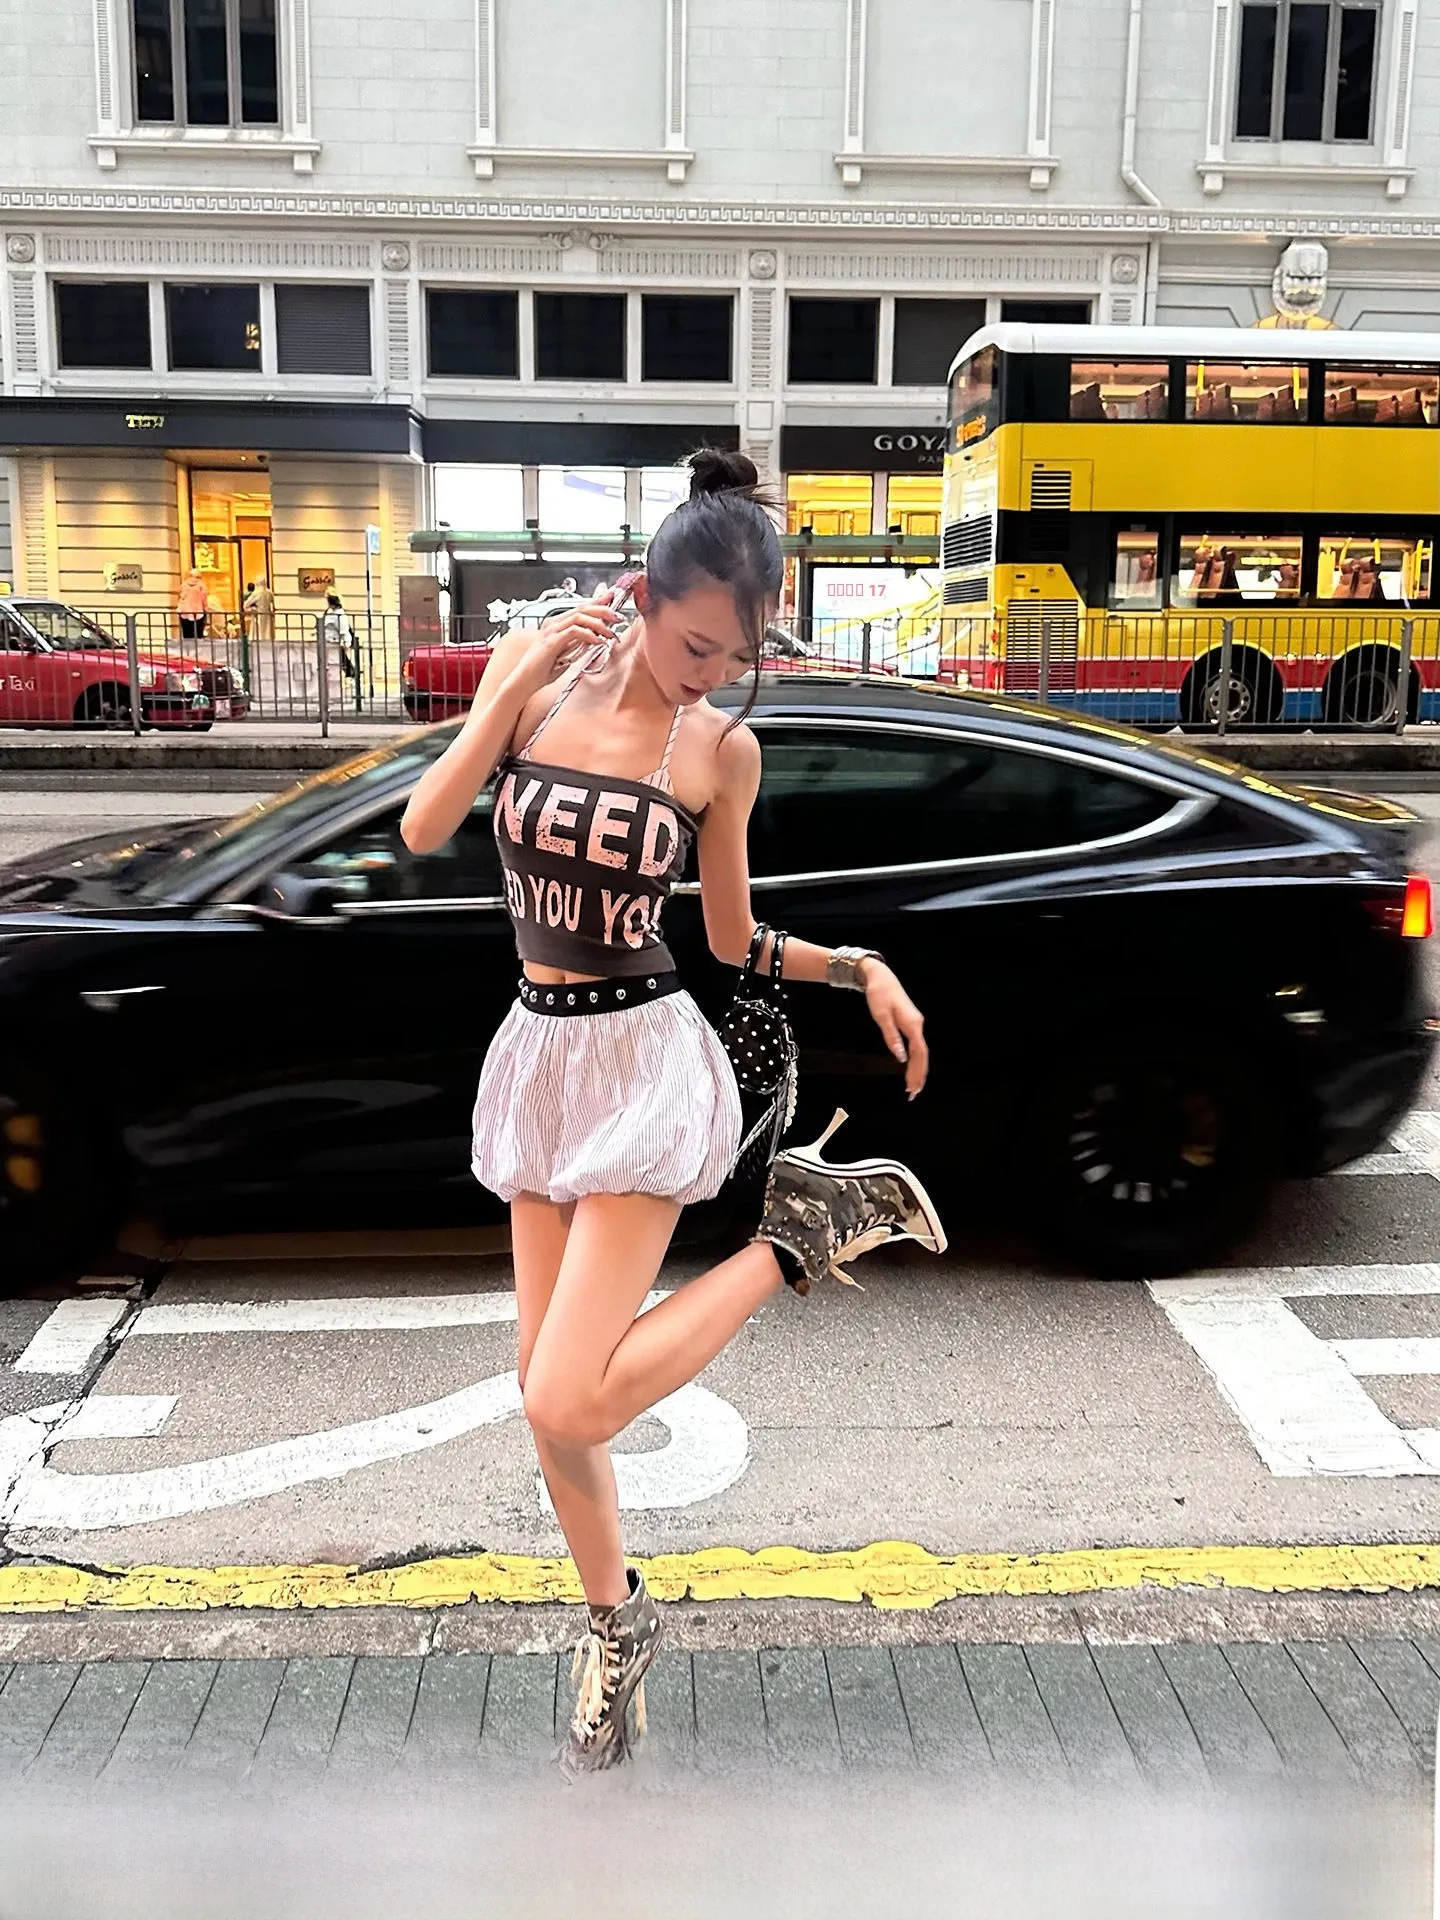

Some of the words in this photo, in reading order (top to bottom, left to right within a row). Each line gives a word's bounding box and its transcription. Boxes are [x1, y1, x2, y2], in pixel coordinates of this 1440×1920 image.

[868, 584, 886, 597] 17
[8, 675, 36, 691] Taxi
[494, 773, 679, 877] NEED
[527, 874, 583, 932] YOU
